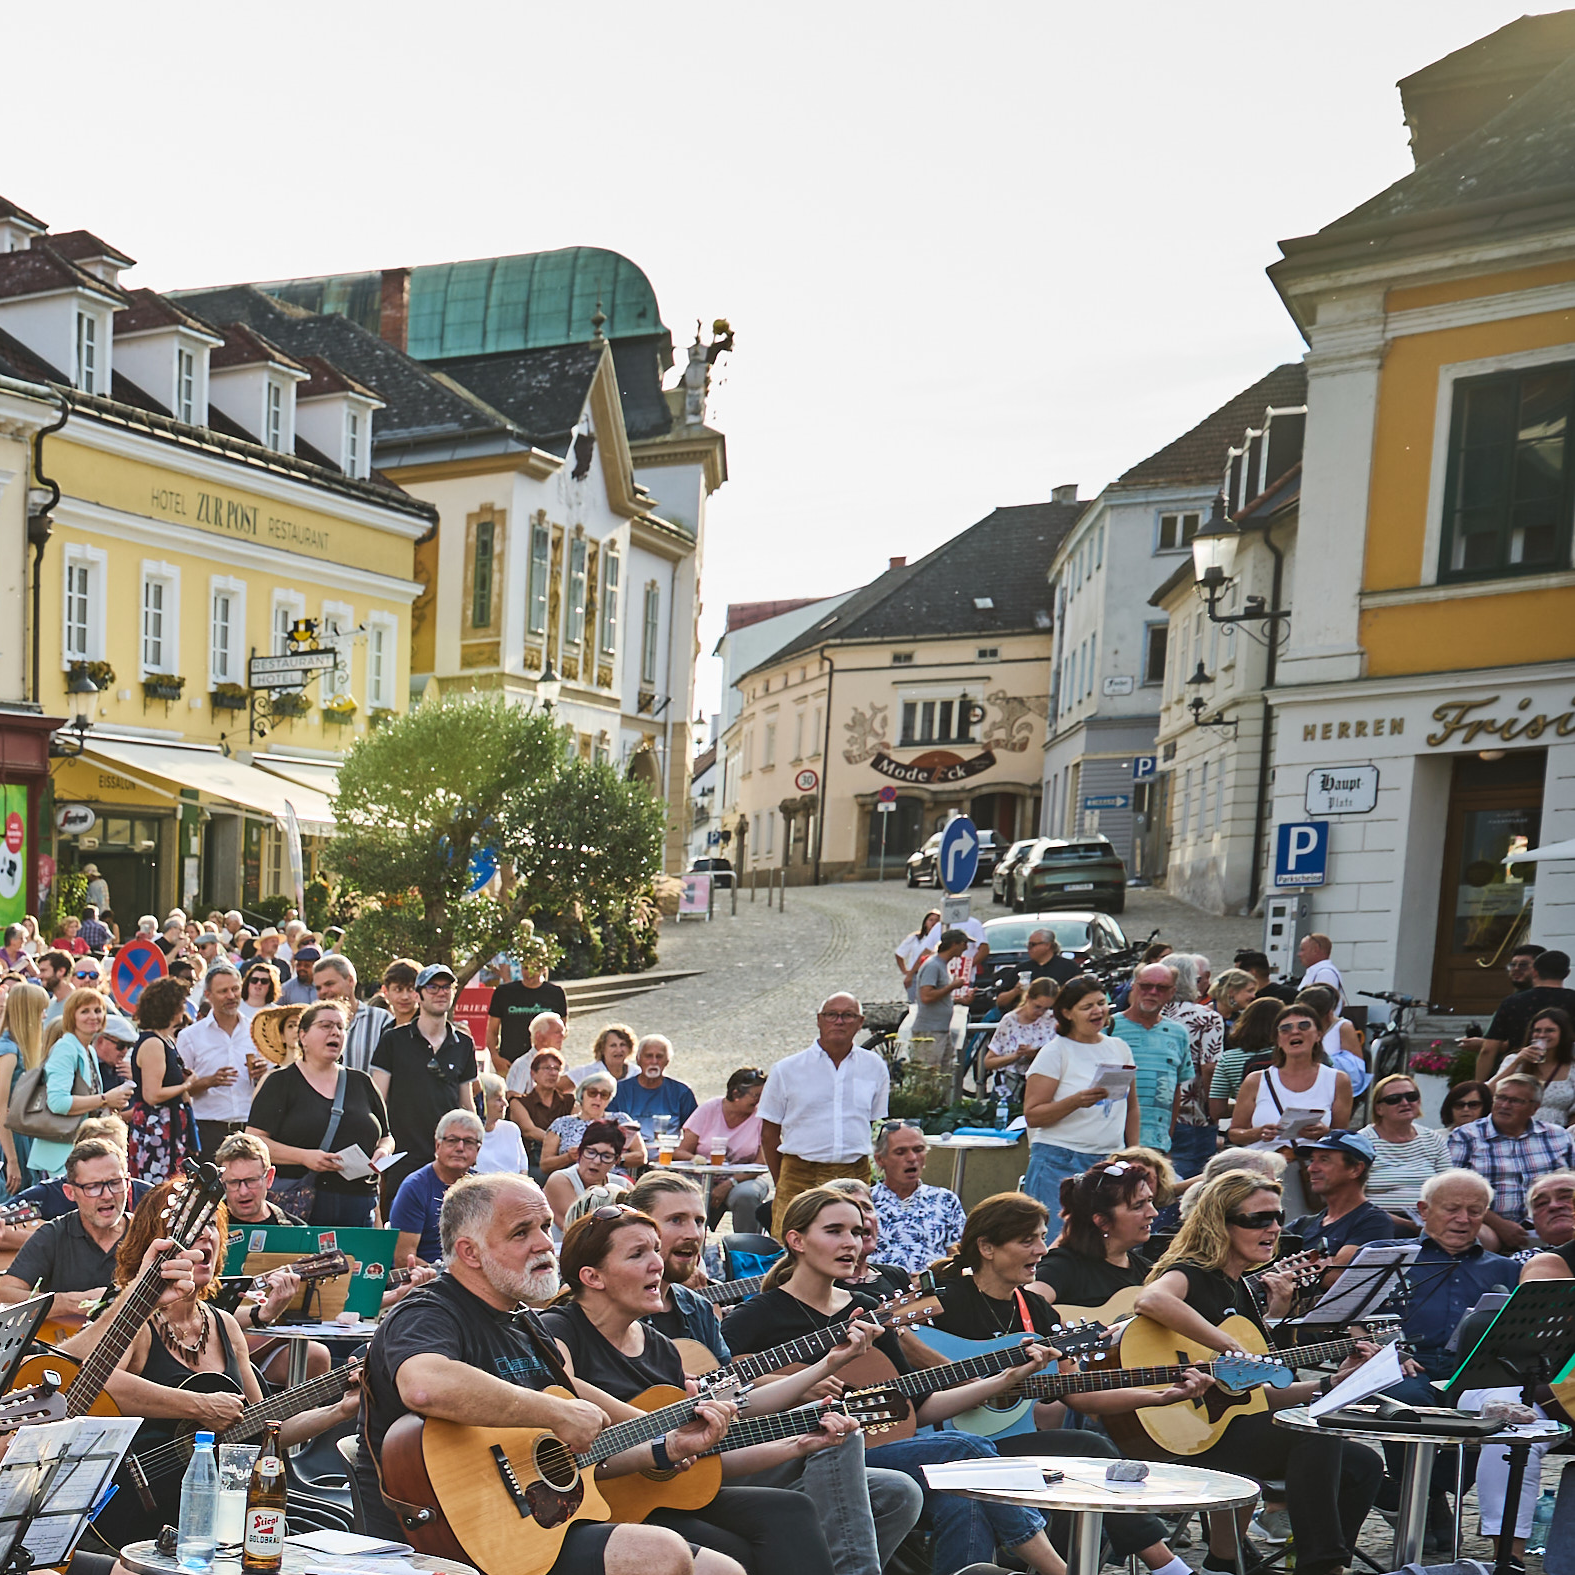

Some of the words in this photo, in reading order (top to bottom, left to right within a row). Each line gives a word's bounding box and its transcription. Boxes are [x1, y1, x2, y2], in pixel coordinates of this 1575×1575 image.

[151, 487, 187, 516] HOTEL
[196, 492, 223, 528] ZUR
[226, 500, 260, 536] POST
[268, 517, 330, 550] RESTAURANT
[252, 656, 332, 671] RESTAURANT
[256, 673, 297, 685] HOTEL
[1303, 717, 1405, 742] HERREN
[878, 758, 928, 782] Mode
[931, 764, 967, 784] Eck
[1138, 757, 1153, 777] P
[98, 774, 136, 791] EISSALON
[801, 774, 813, 786] 30
[1287, 826, 1319, 871] P
[1277, 873, 1323, 884] Parkscheine
[455, 1004, 489, 1012] URIER
[253, 1514, 279, 1529] Stiegl
[249, 1534, 280, 1544] GOLDBRÄU
